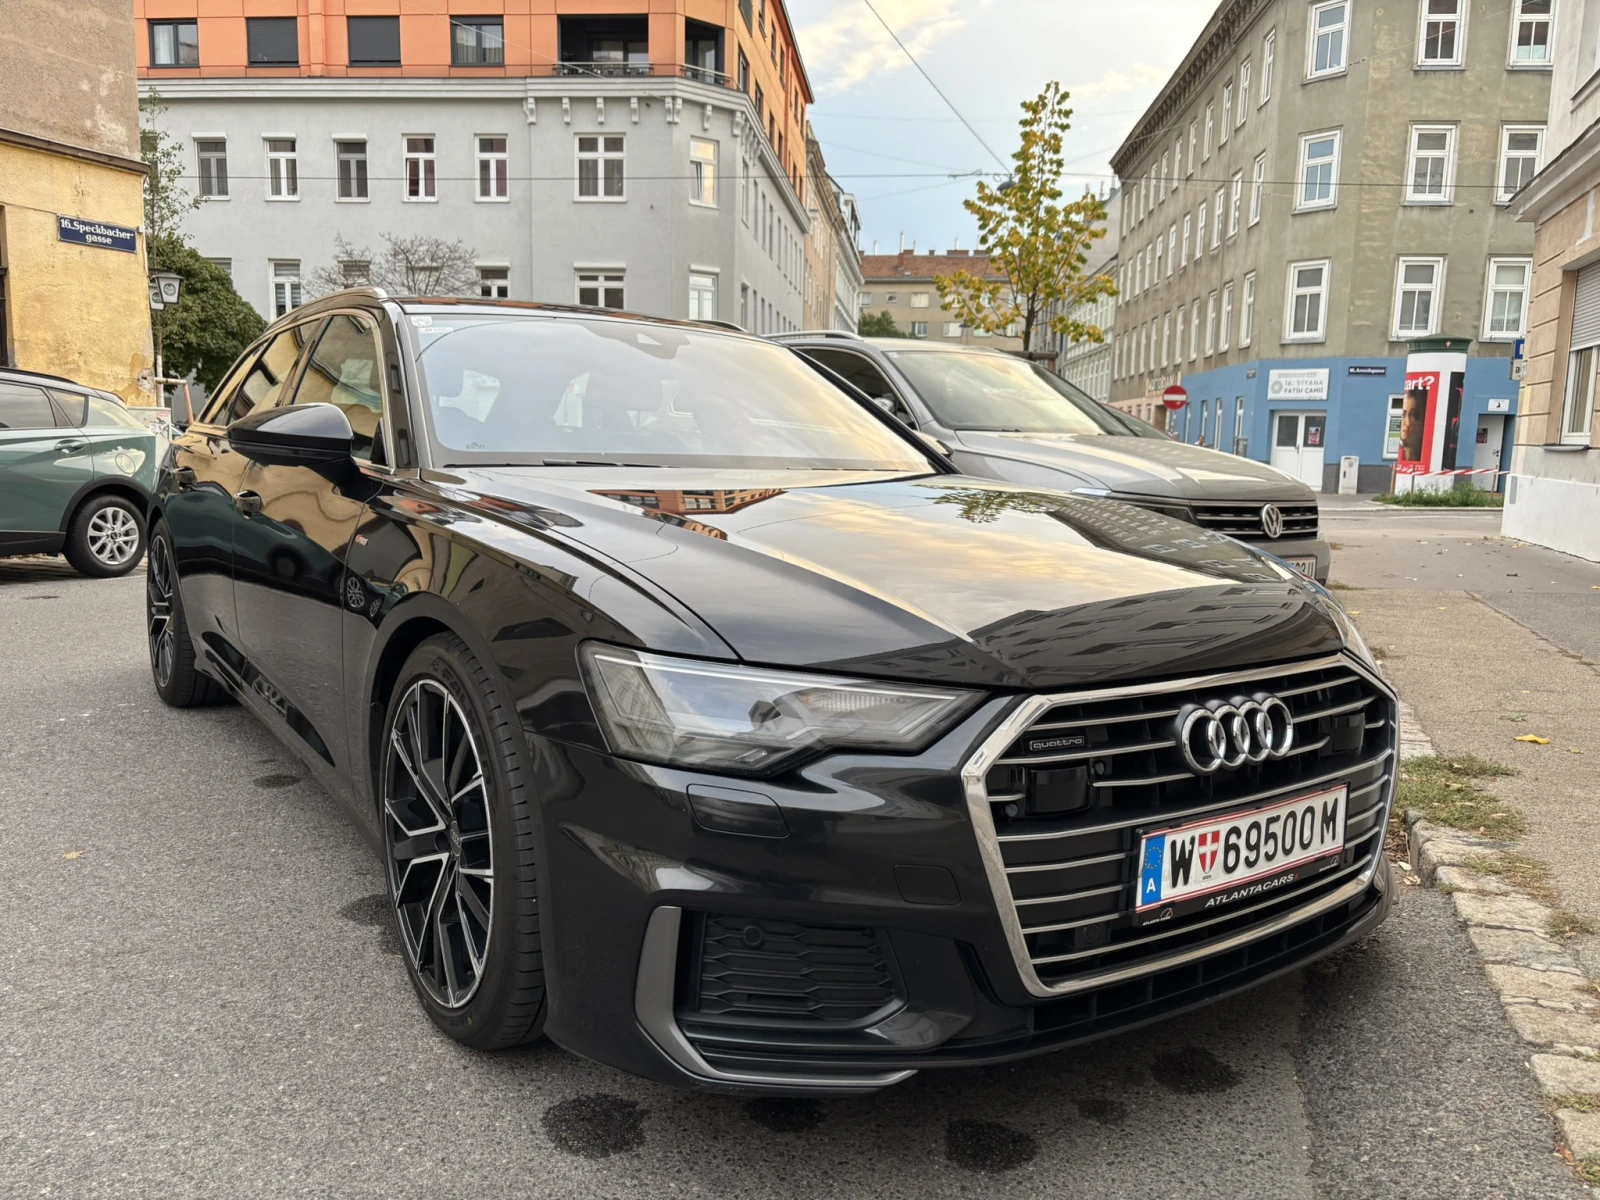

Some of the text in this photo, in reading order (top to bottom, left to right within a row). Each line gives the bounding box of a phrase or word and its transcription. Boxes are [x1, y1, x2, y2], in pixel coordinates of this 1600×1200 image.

[86, 234, 112, 244] gasse
[1033, 738, 1083, 750] quattro
[1170, 834, 1196, 889] W
[1146, 877, 1156, 894] A
